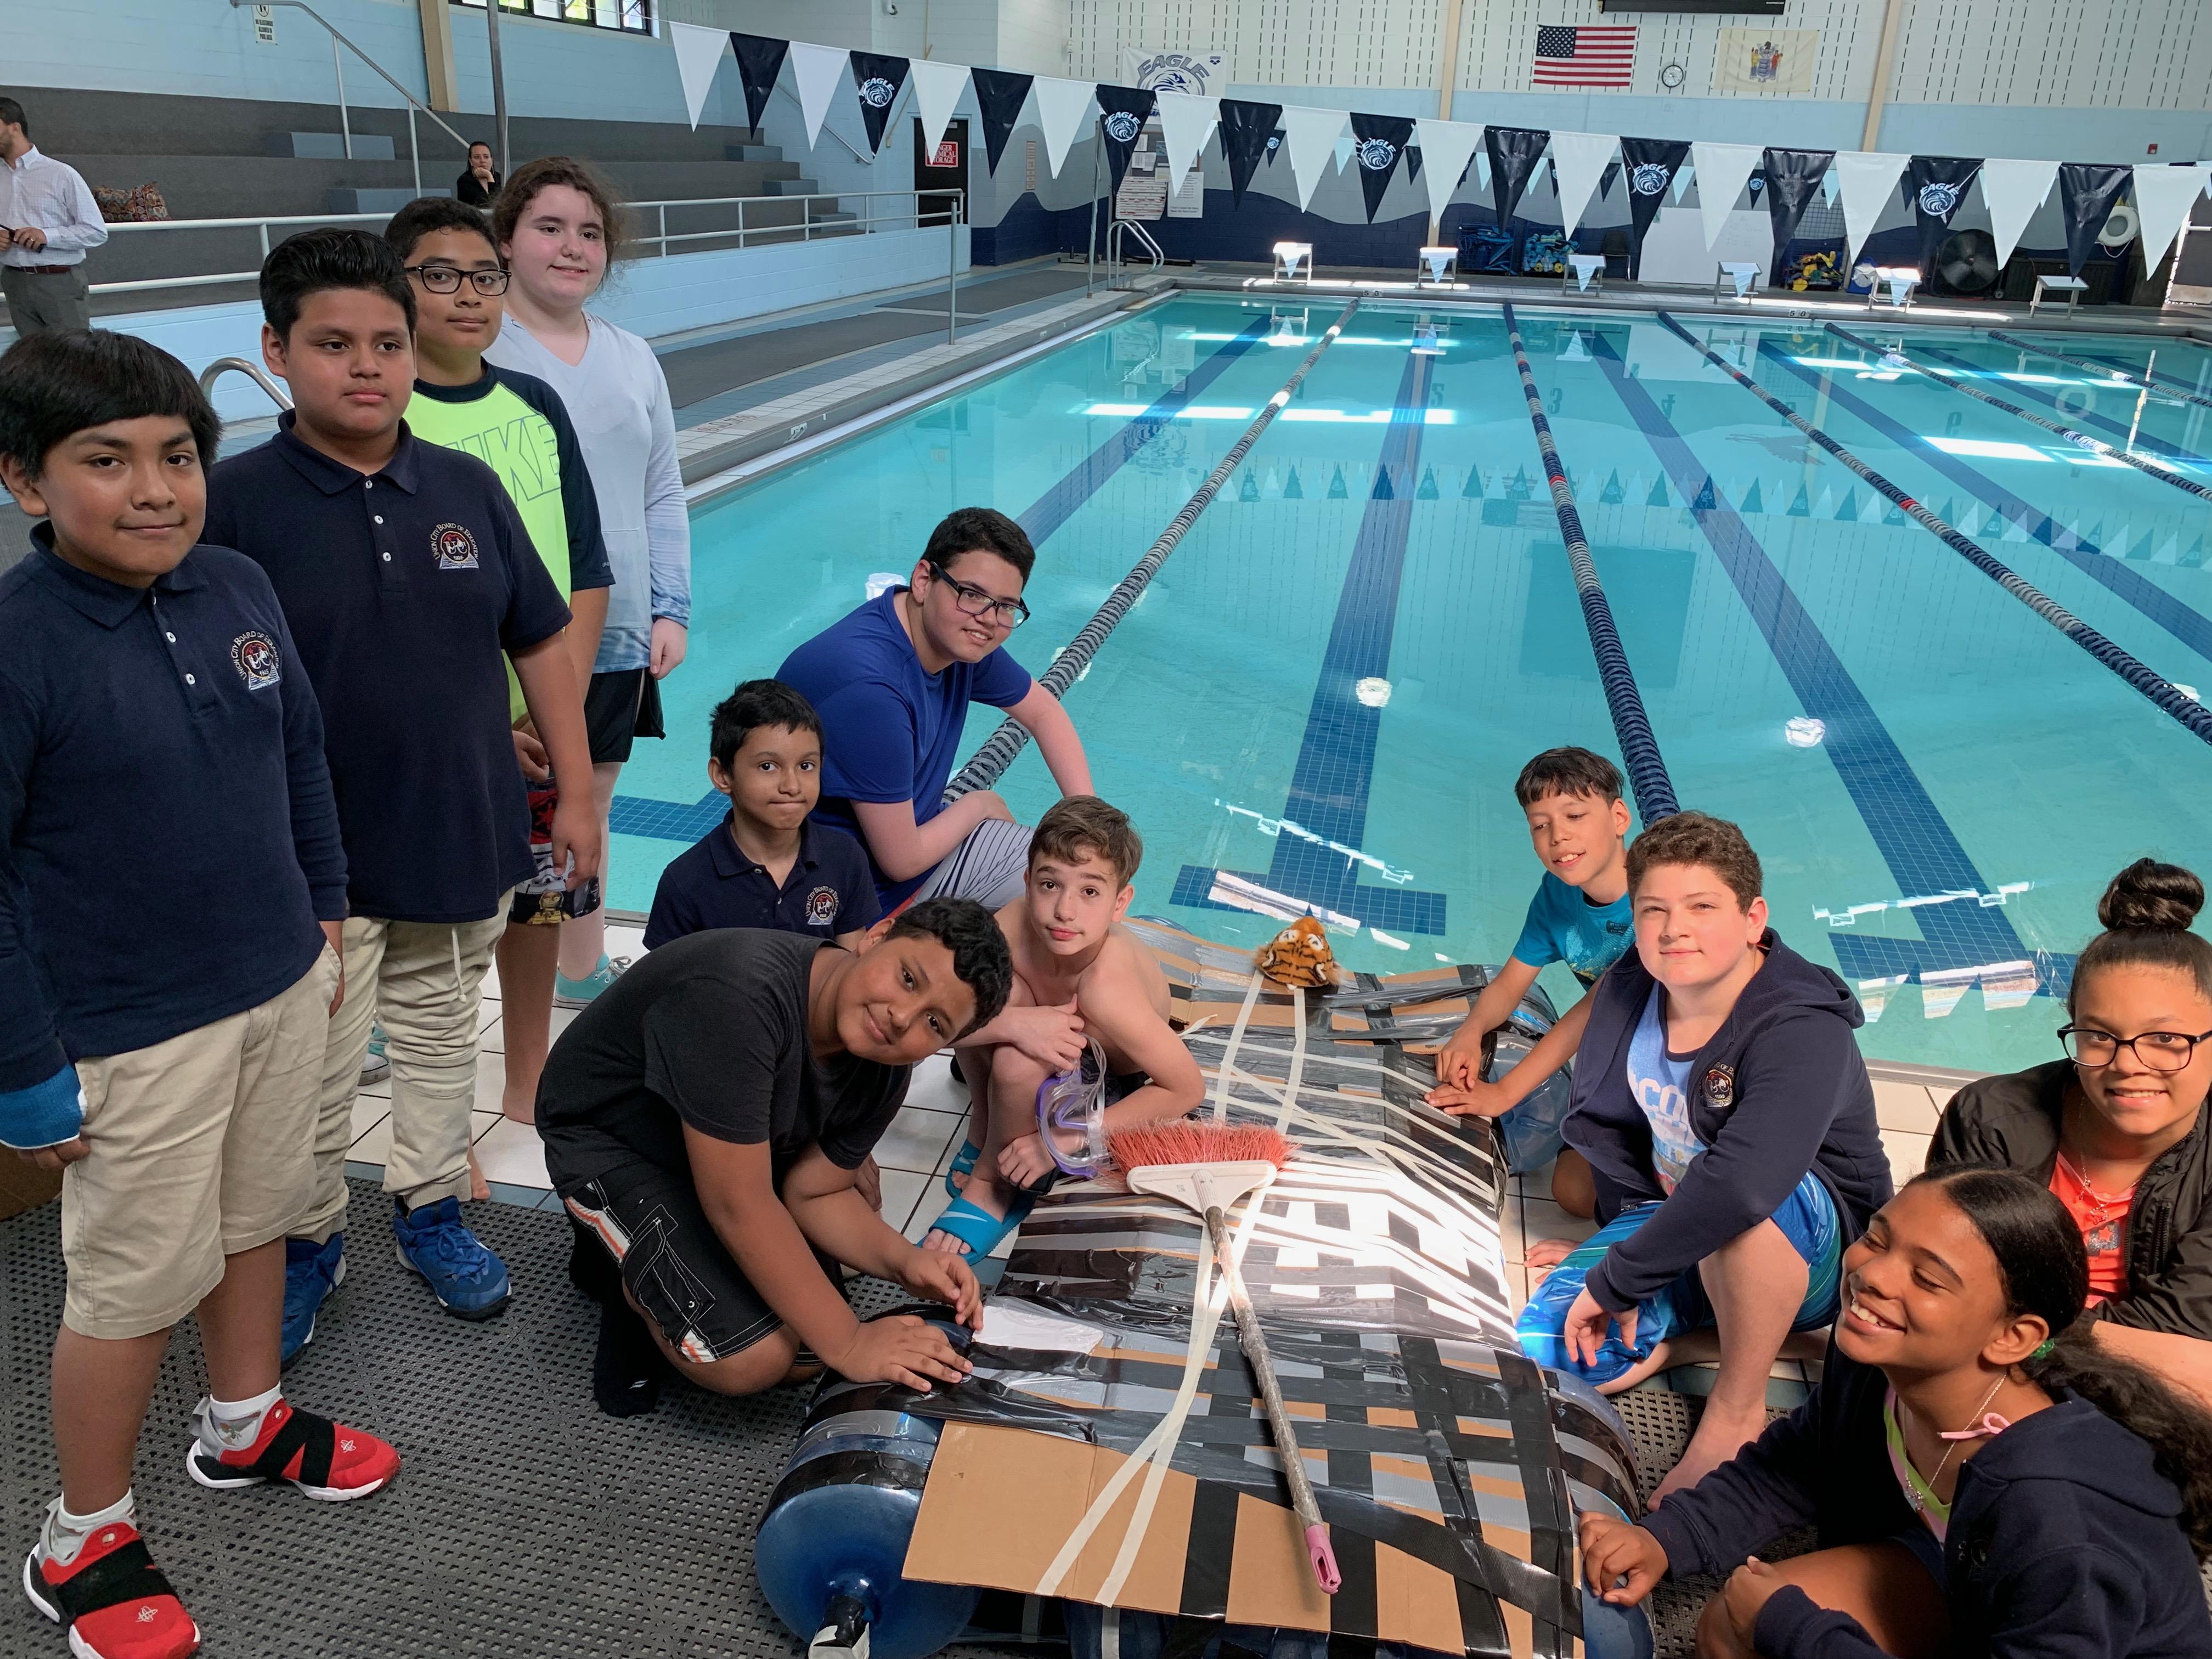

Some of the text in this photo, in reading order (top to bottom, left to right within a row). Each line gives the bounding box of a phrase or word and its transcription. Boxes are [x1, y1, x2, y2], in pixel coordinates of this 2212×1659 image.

[1137, 54, 1210, 78] EAGLE
[864, 77, 895, 91] EAGLE
[1108, 111, 1141, 125] EAGLE
[1362, 139, 1396, 152] EAGLE
[1634, 163, 1670, 177] EAGLE
[1920, 183, 1959, 196] EAGLE
[436, 522, 456, 532] BOARD
[430, 529, 441, 540] CITY
[430, 541, 441, 560] UNION
[464, 528, 479, 560] EDUCATION
[234, 630, 256, 646] BOARD
[231, 644, 239, 658] CITY
[233, 659, 247, 680] UNION
[808, 890, 816, 901] CITY
[1720, 1063, 1729, 1071] OF
